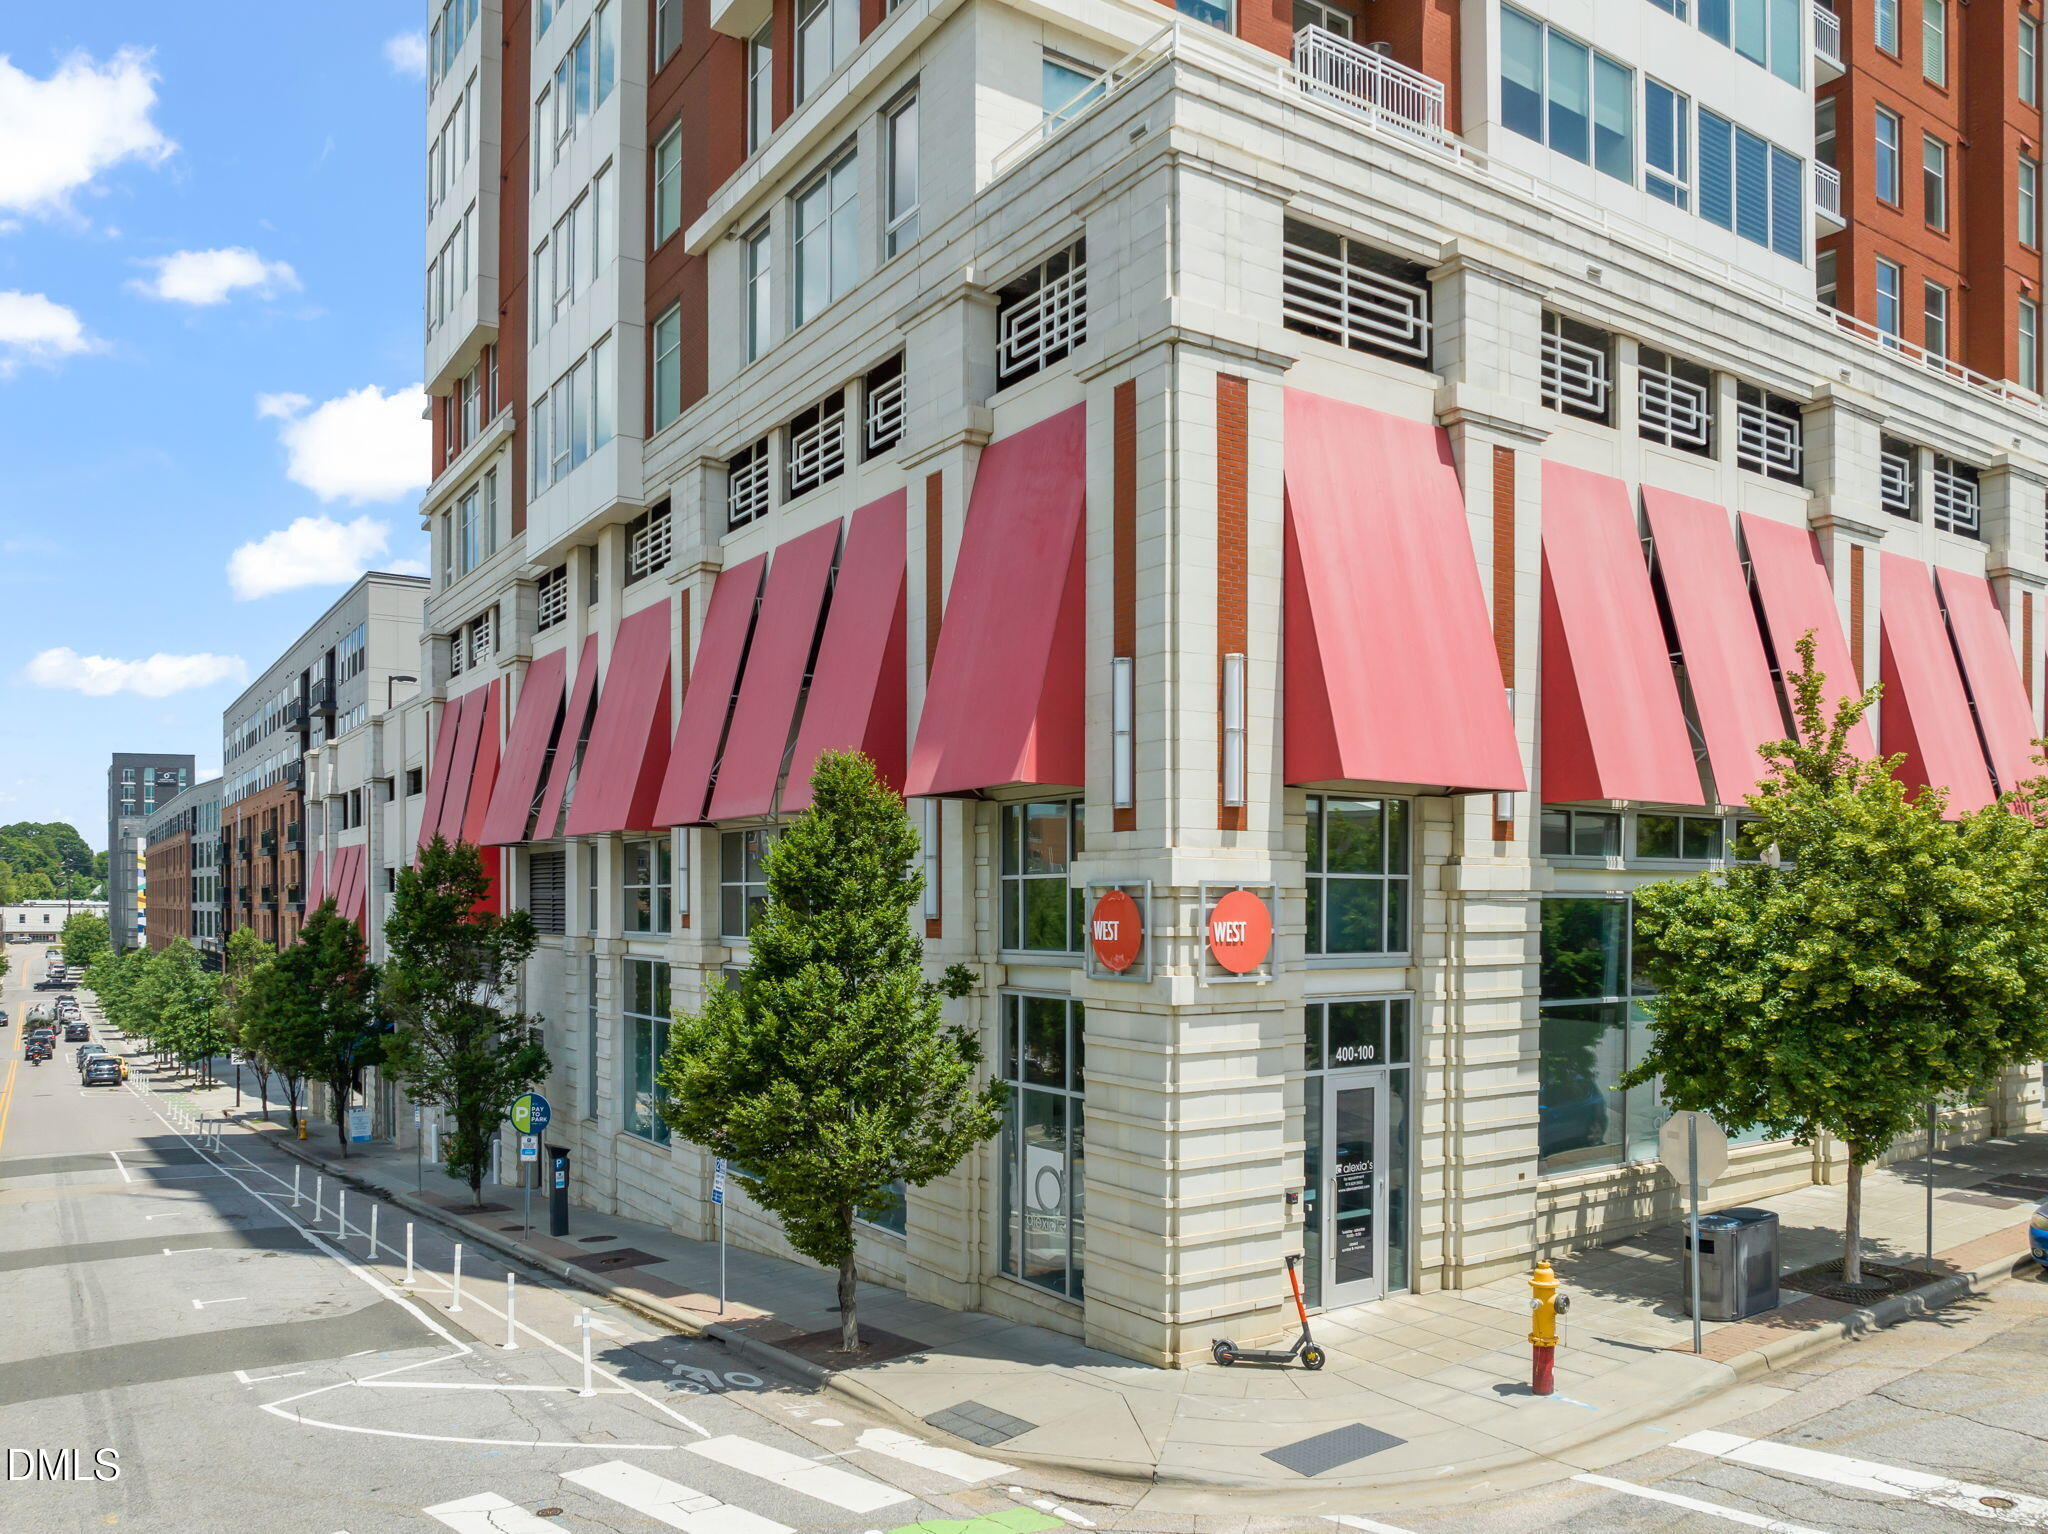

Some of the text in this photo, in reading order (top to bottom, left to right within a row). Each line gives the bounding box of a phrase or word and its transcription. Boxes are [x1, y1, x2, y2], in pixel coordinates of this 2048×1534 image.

[1093, 920, 1119, 941] WEST
[1213, 921, 1247, 943] WEST
[1335, 1044, 1375, 1062] 400-100
[515, 1106, 529, 1122] P
[1343, 1159, 1374, 1173] alexia's
